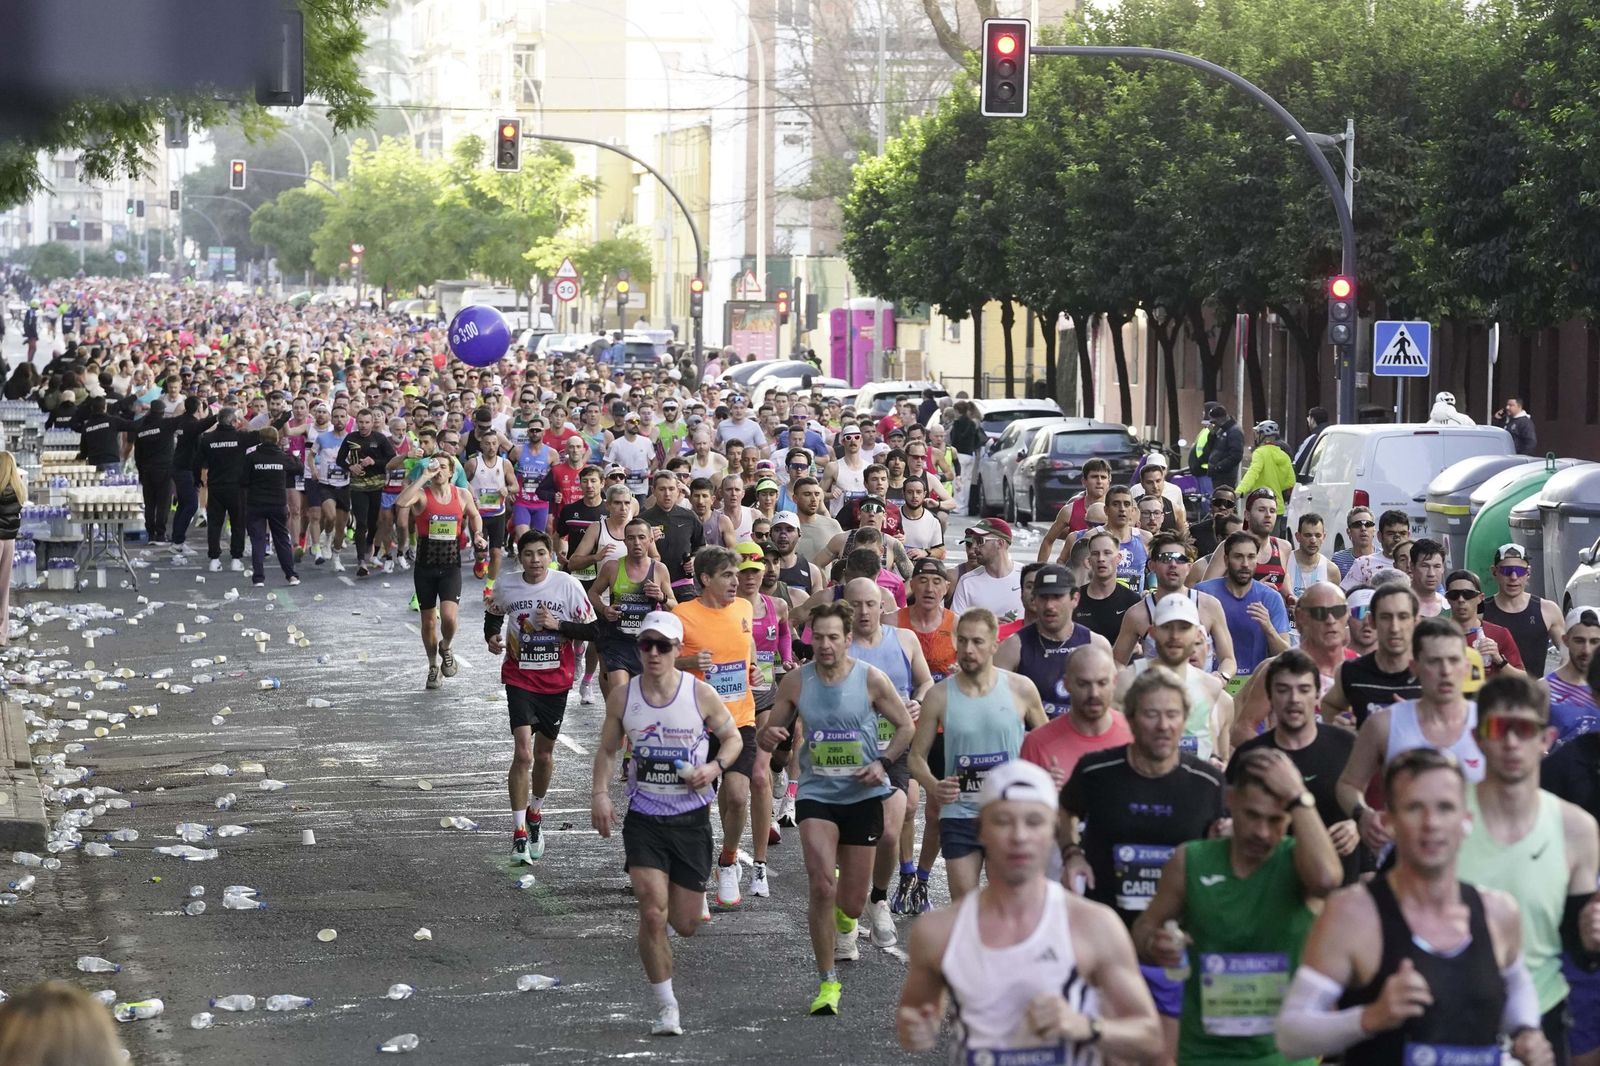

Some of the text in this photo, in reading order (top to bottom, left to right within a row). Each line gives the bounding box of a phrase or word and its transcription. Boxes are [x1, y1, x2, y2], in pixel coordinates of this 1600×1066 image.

[560, 286, 573, 294] 30
[458, 321, 479, 342] 3:00
[86, 422, 109, 432] VOLUNTEER
[138, 427, 161, 438] VOLUNTEER
[210, 441, 238, 449] VOLUNTEER
[520, 652, 559, 661] M.LUCERO
[720, 662, 743, 672] ZURICH
[662, 726, 695, 735] Fenland
[827, 731, 856, 740] ZURICH
[652, 749, 683, 757] ZURICH
[826, 755, 858, 765] ANGEL
[973, 755, 1004, 765] ZURICH
[645, 771, 679, 784] AARON
